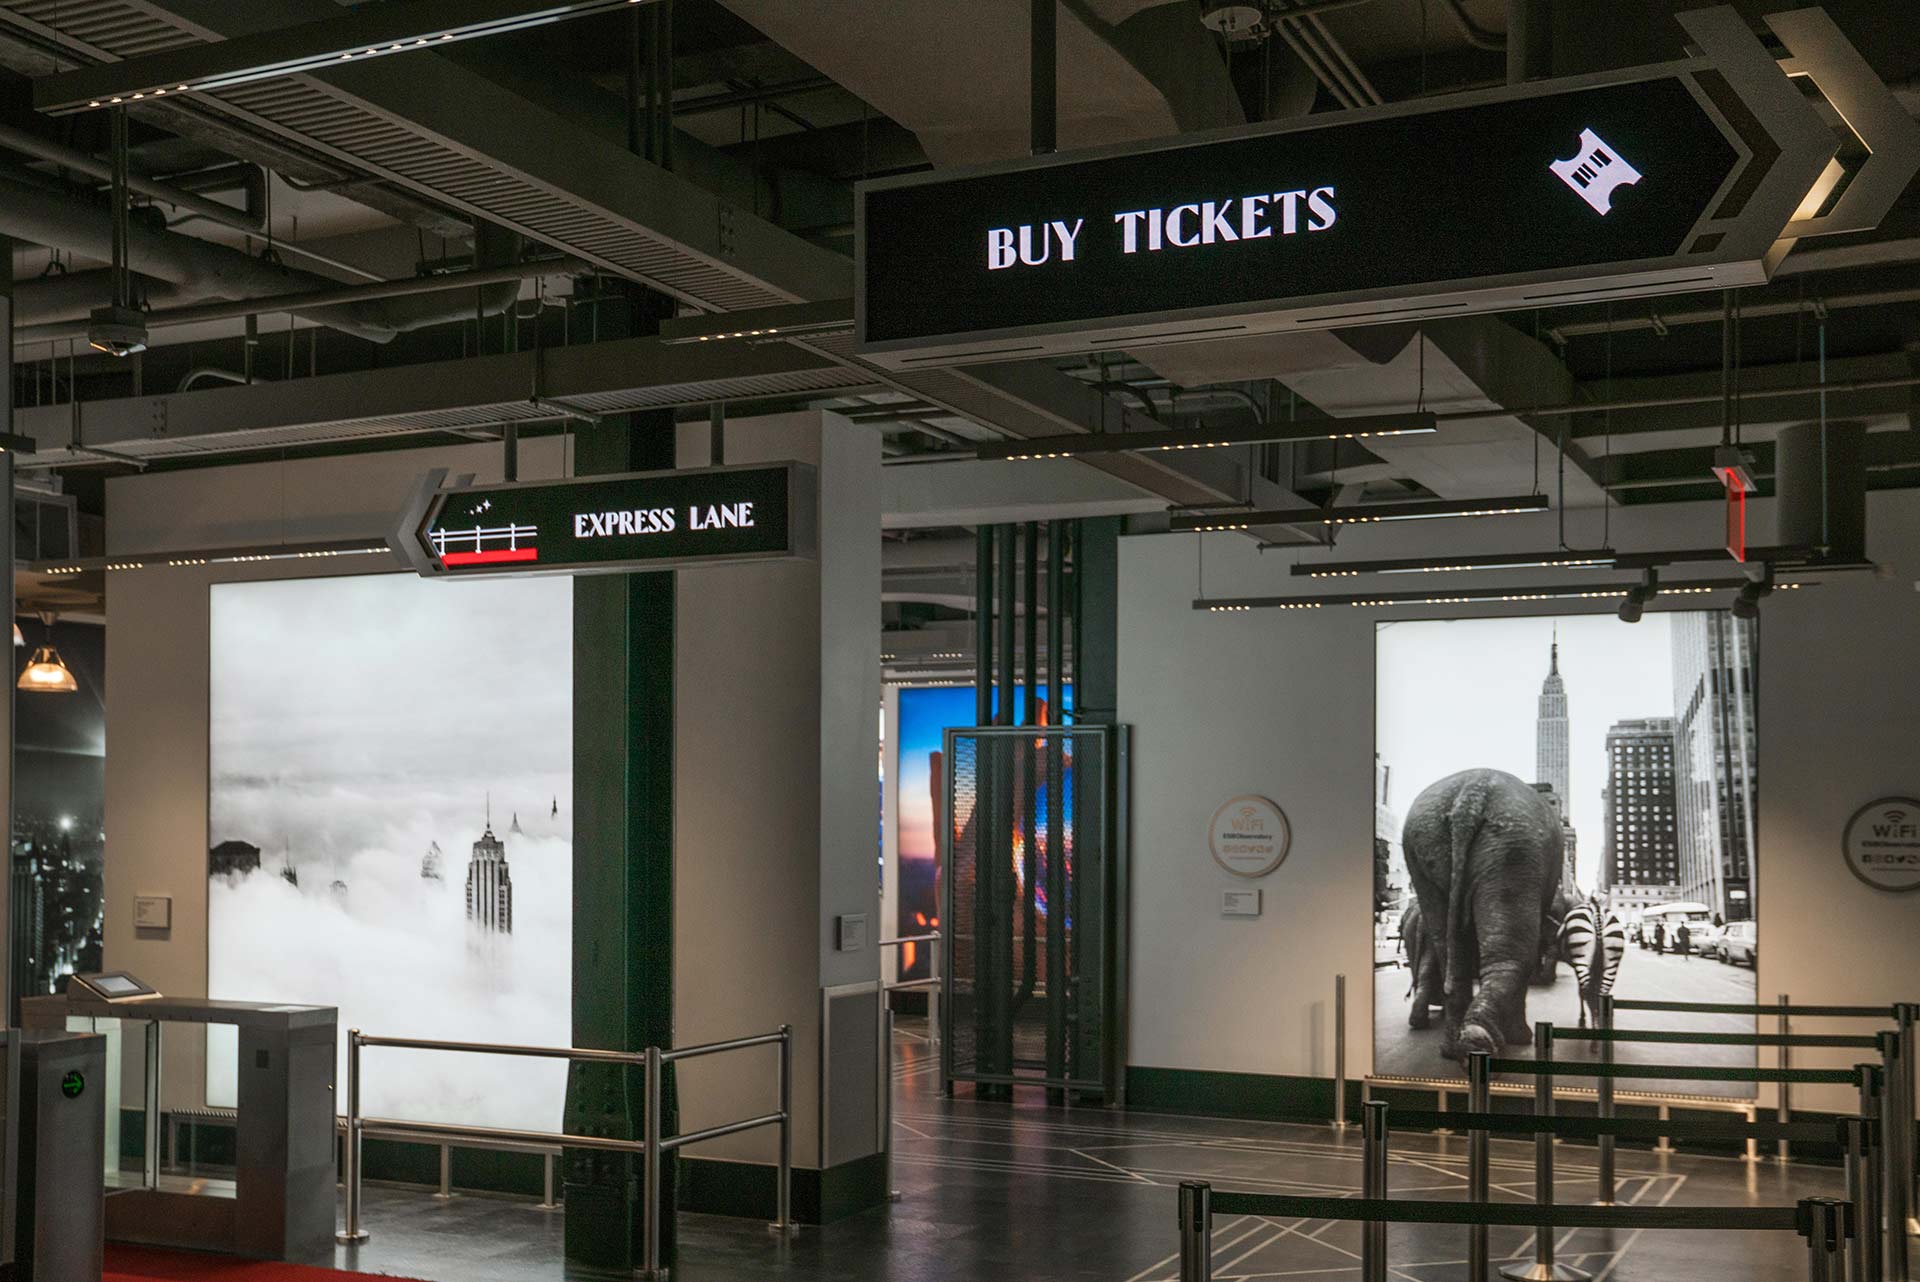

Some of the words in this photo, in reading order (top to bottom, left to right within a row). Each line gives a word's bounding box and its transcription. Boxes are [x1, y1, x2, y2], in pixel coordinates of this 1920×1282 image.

[988, 218, 1084, 270] BUY
[1114, 186, 1337, 254] TICKETS
[574, 507, 676, 538] EXPRESS
[690, 502, 755, 530] LANE
[1872, 824, 1917, 838] WiFi
